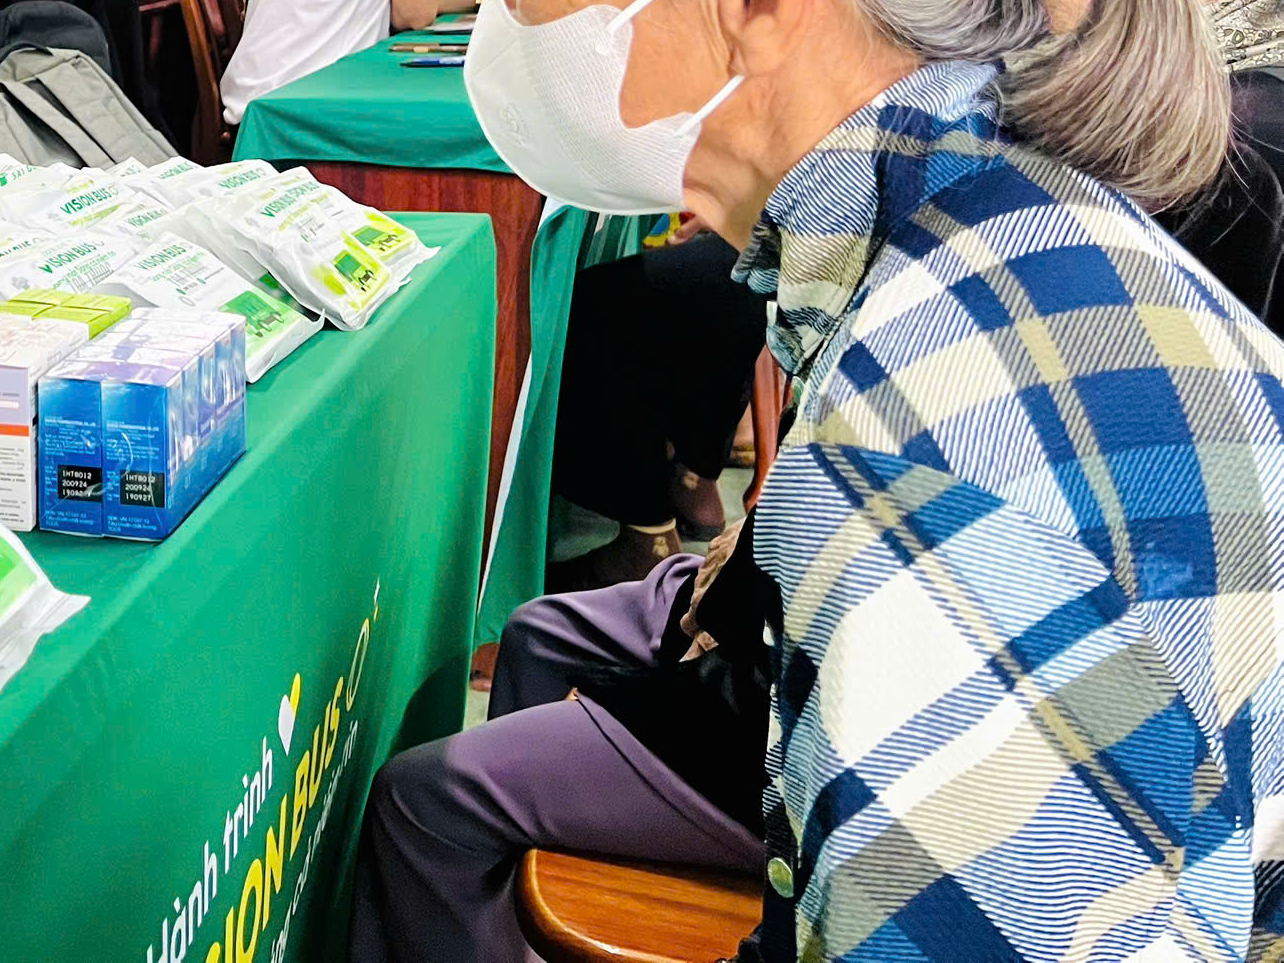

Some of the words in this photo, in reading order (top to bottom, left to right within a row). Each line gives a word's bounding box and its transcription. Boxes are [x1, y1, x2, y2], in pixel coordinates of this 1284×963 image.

[59, 192, 95, 215] VISION
[94, 187, 112, 204] BUS
[223, 735, 273, 875] trình
[289, 676, 344, 862] BUS
